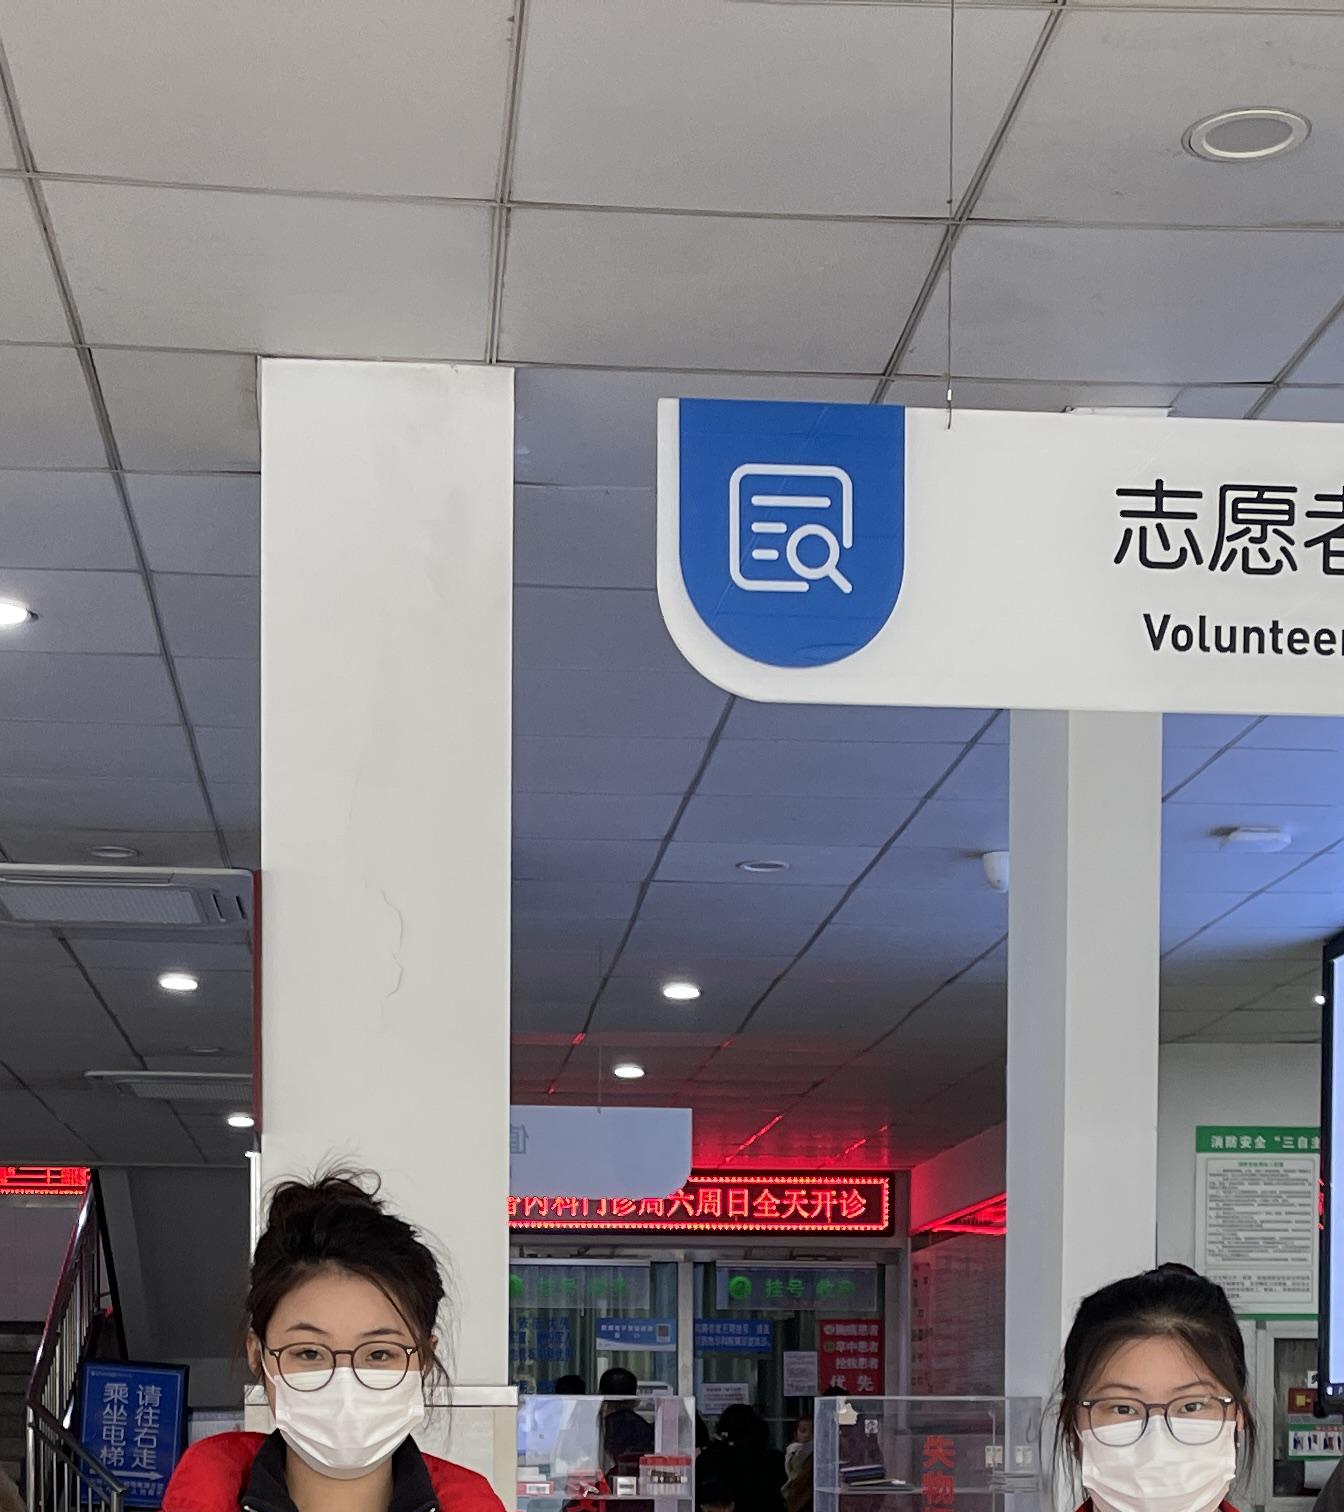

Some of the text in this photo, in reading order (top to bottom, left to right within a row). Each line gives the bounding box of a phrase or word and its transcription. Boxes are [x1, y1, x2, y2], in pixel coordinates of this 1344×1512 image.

[766, 1279, 805, 1298] 挂号
[100, 1383, 129, 1467] 乘坐电梯
[131, 1384, 162, 1470] 请往右走
